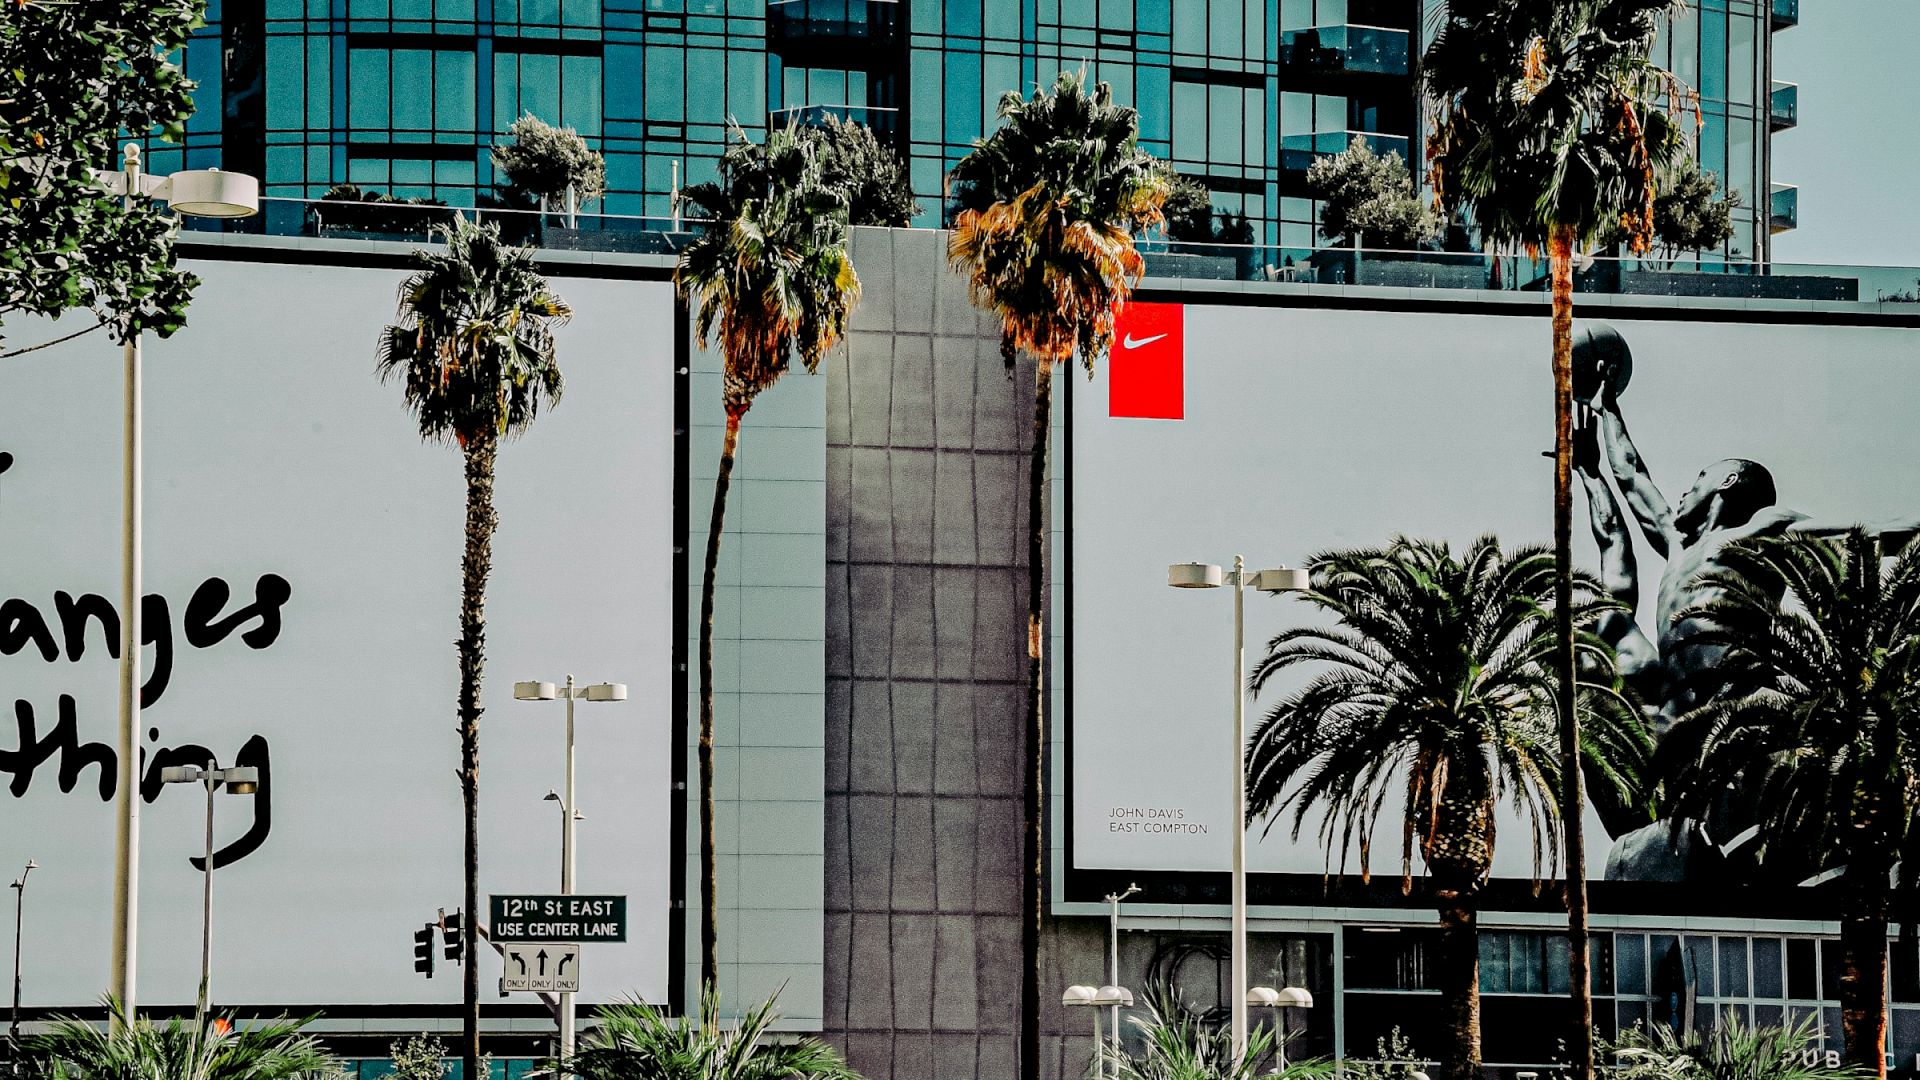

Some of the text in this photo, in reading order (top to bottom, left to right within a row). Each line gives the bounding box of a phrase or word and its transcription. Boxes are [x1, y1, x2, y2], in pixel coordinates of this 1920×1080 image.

[1109, 808, 1184, 819] JOHN DAVIS
[1109, 822, 1208, 834] EAST COMPTON
[502, 899, 614, 917] 12th St EAST
[497, 923, 618, 936] USE CENTER LANE
[506, 979, 576, 989] ONLY ONLY ONLY
